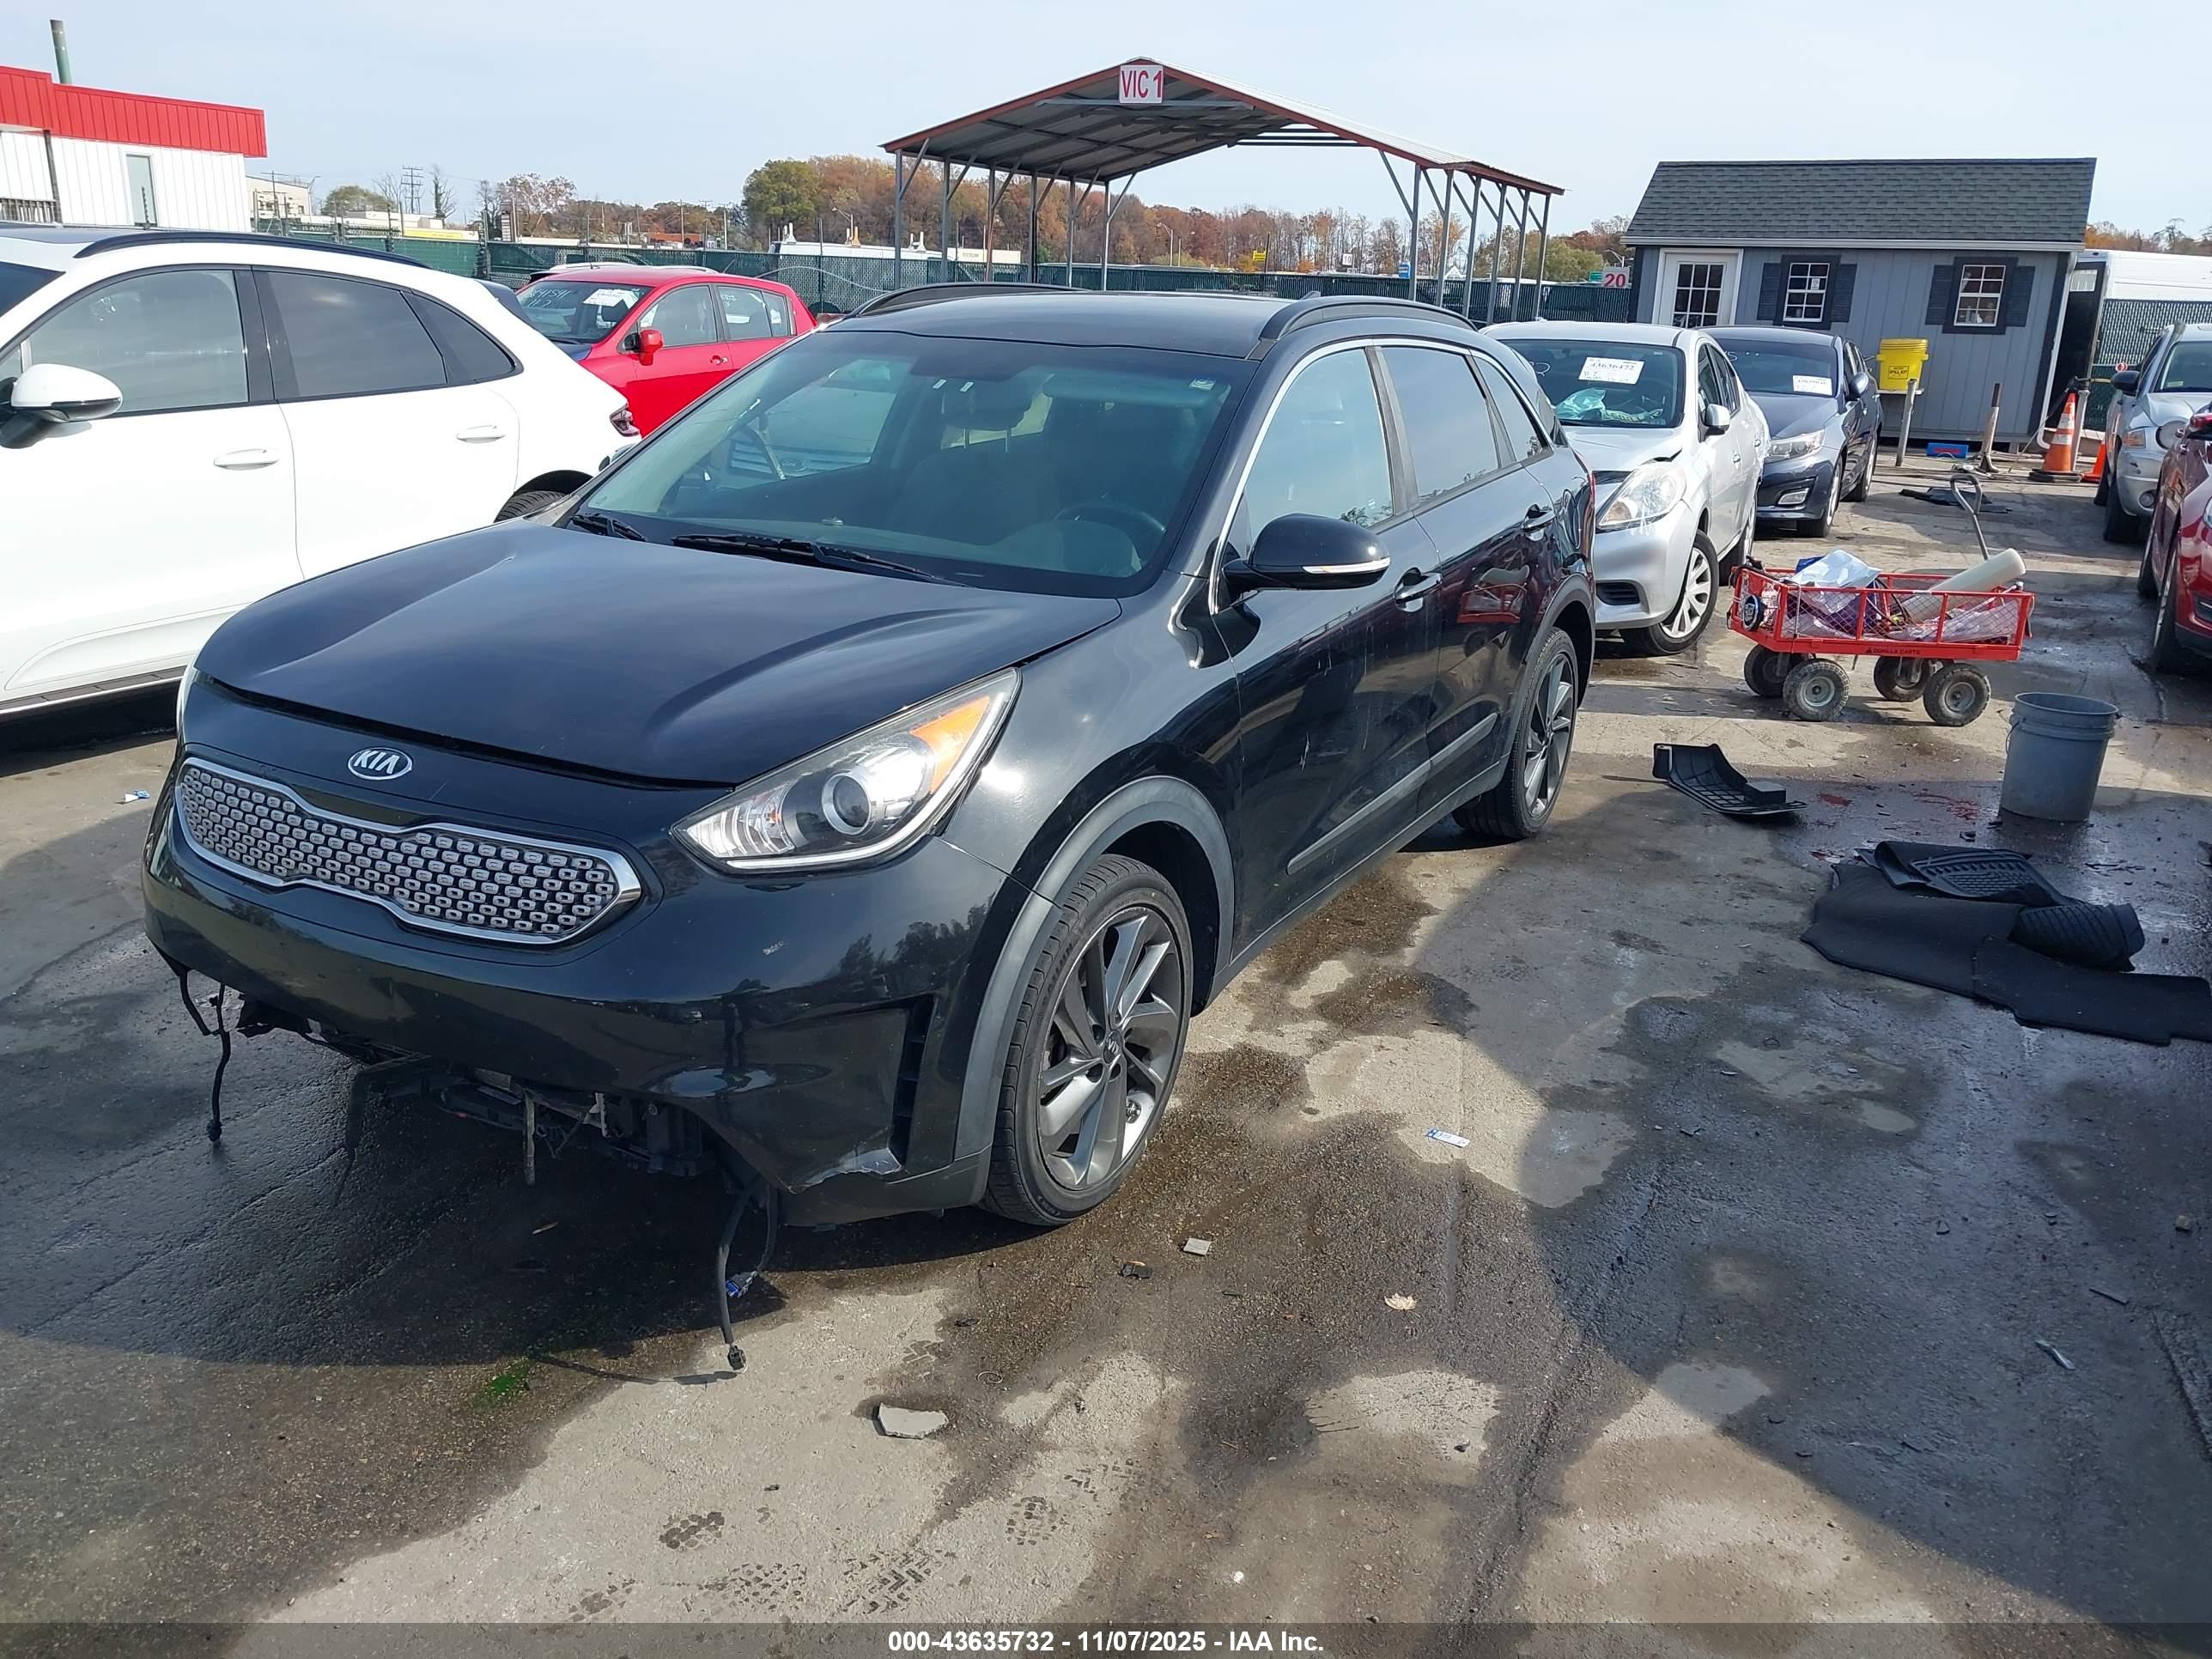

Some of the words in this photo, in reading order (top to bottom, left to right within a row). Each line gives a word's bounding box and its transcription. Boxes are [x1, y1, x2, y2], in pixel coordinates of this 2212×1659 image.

[1121, 70, 1149, 98] VIC
[1153, 70, 1162, 98] 1
[1604, 273, 1626, 288] 20
[353, 750, 400, 775] KIA
